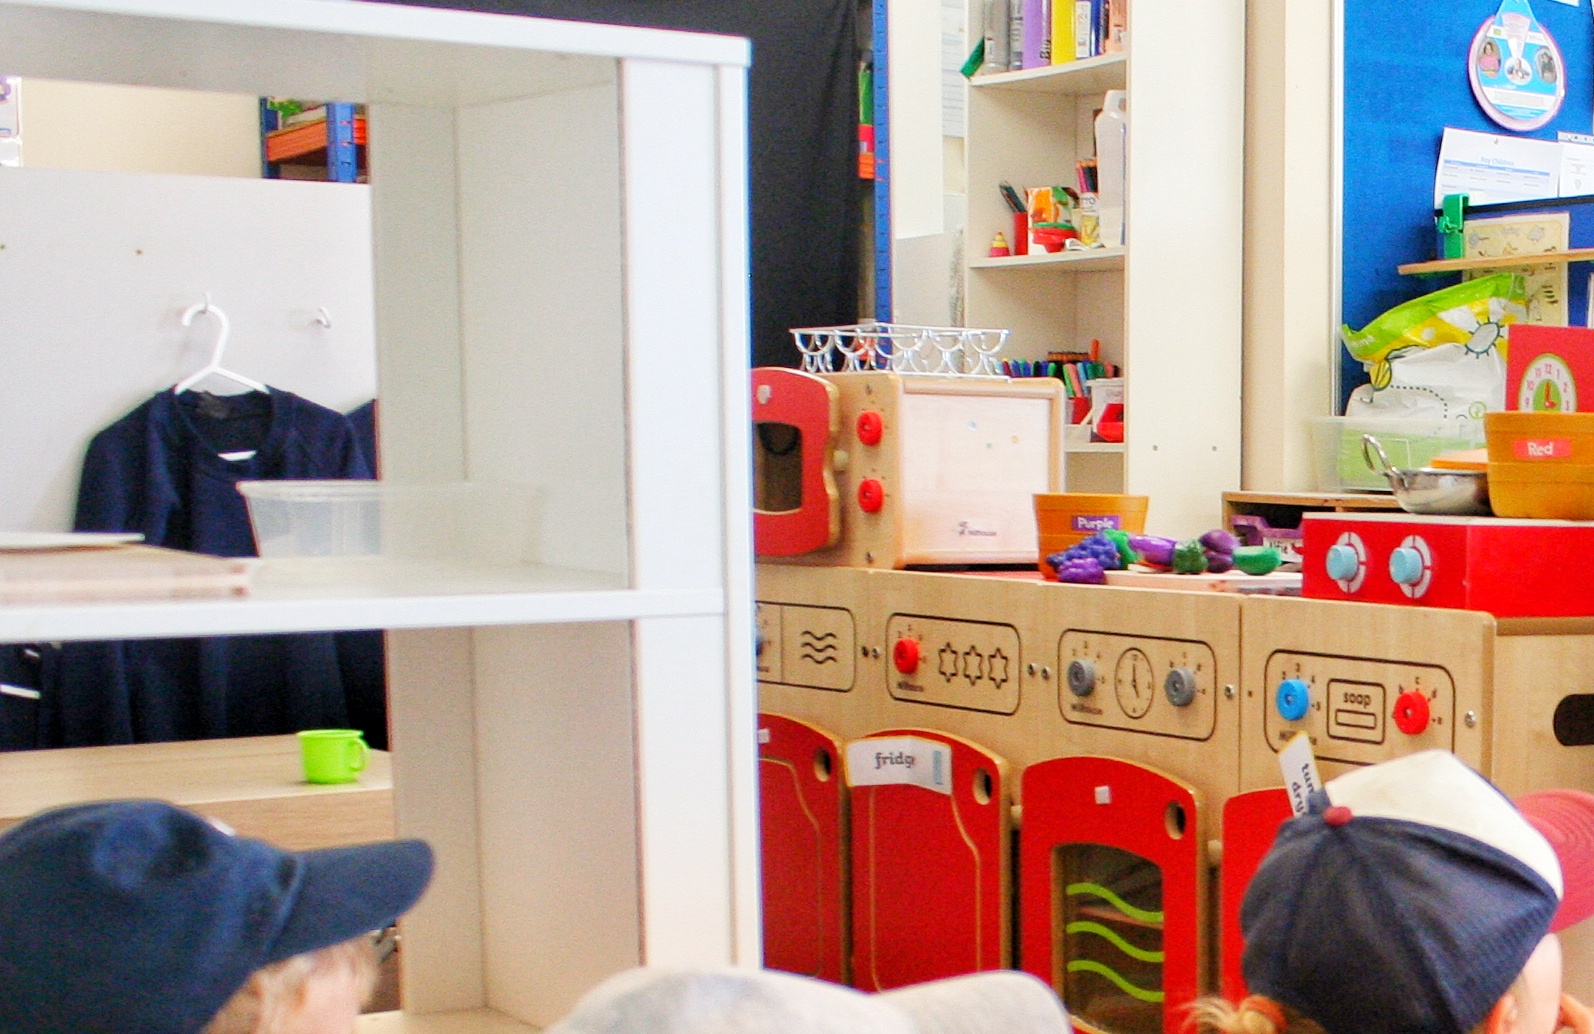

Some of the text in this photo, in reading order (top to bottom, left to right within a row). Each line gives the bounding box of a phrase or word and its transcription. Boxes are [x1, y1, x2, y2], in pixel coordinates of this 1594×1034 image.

[1526, 441, 1554, 456] Red
[1077, 516, 1114, 531] Purple
[1343, 691, 1372, 709] soap
